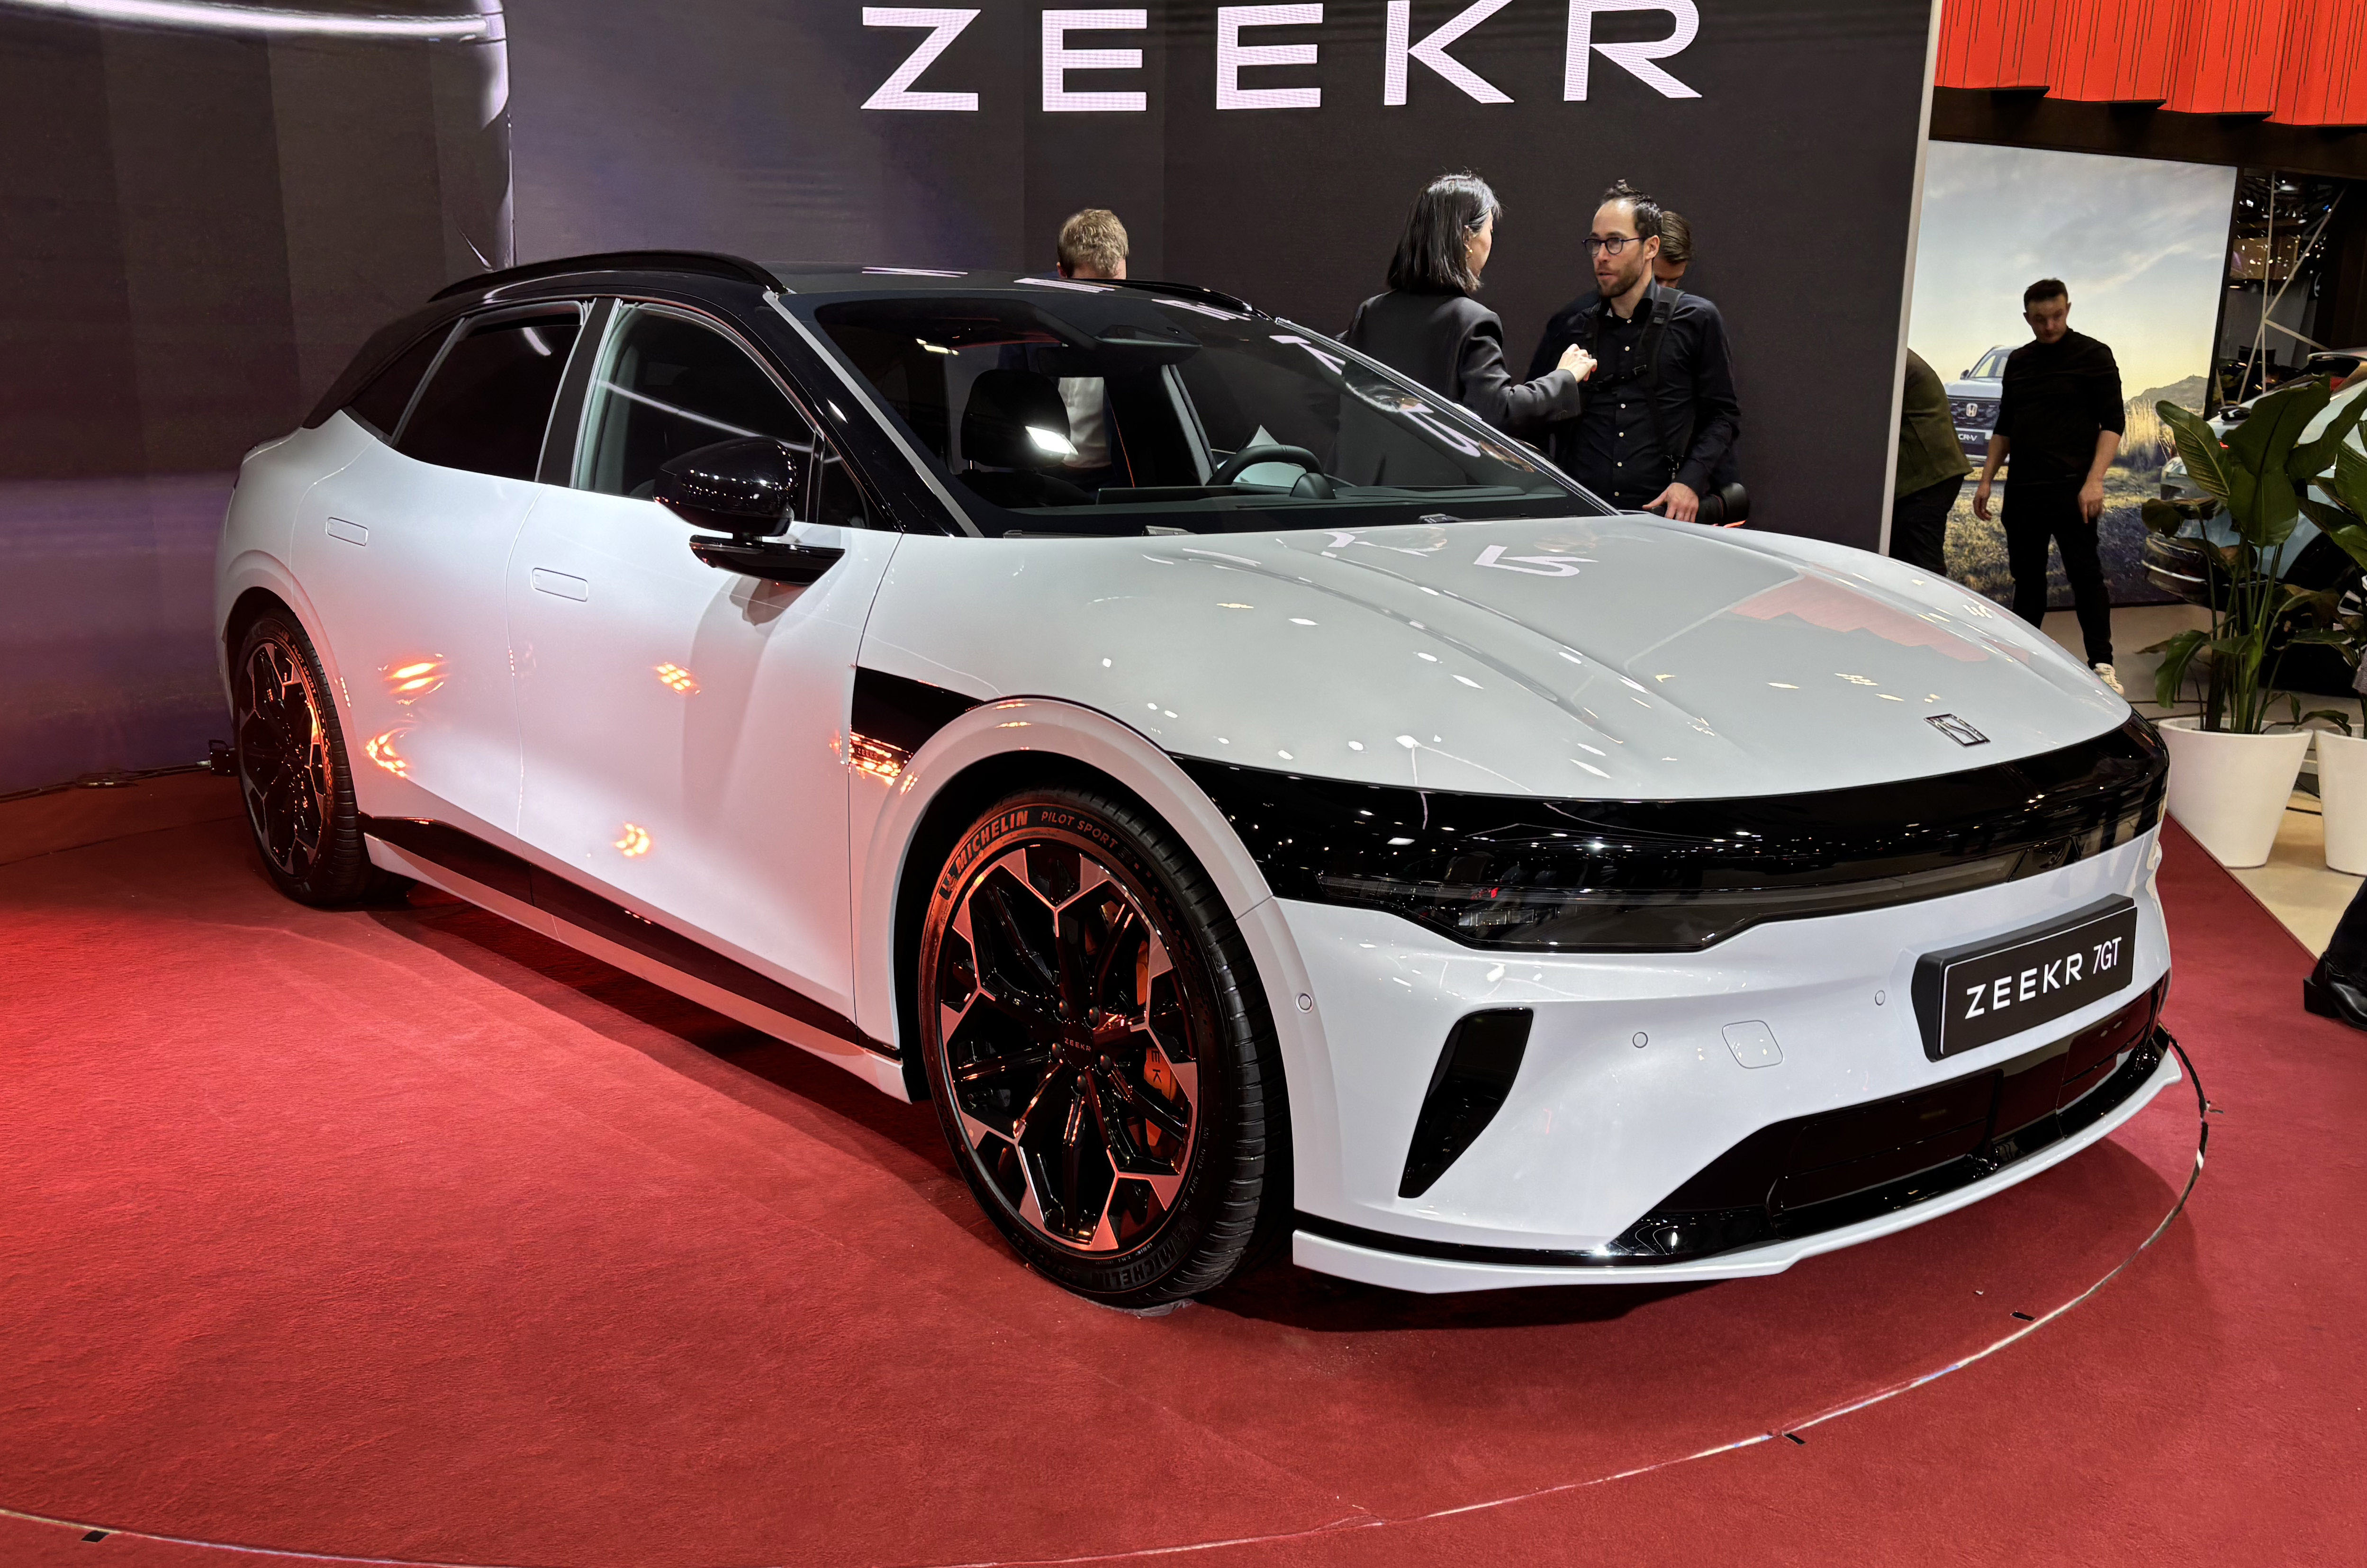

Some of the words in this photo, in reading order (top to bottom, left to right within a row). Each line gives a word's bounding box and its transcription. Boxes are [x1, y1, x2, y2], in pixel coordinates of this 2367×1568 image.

[860, 0, 1702, 112] ZEEKR
[955, 810, 1029, 874] MICHELIN
[1041, 811, 1075, 826] PILOT
[1077, 820, 1119, 848] SPORT
[1965, 952, 2082, 1019] ZEEKR
[2092, 936, 2122, 974] 7GT
[1064, 1037, 1091, 1053] ZEEKR
[1091, 1239, 1178, 1287] MICHELIN
